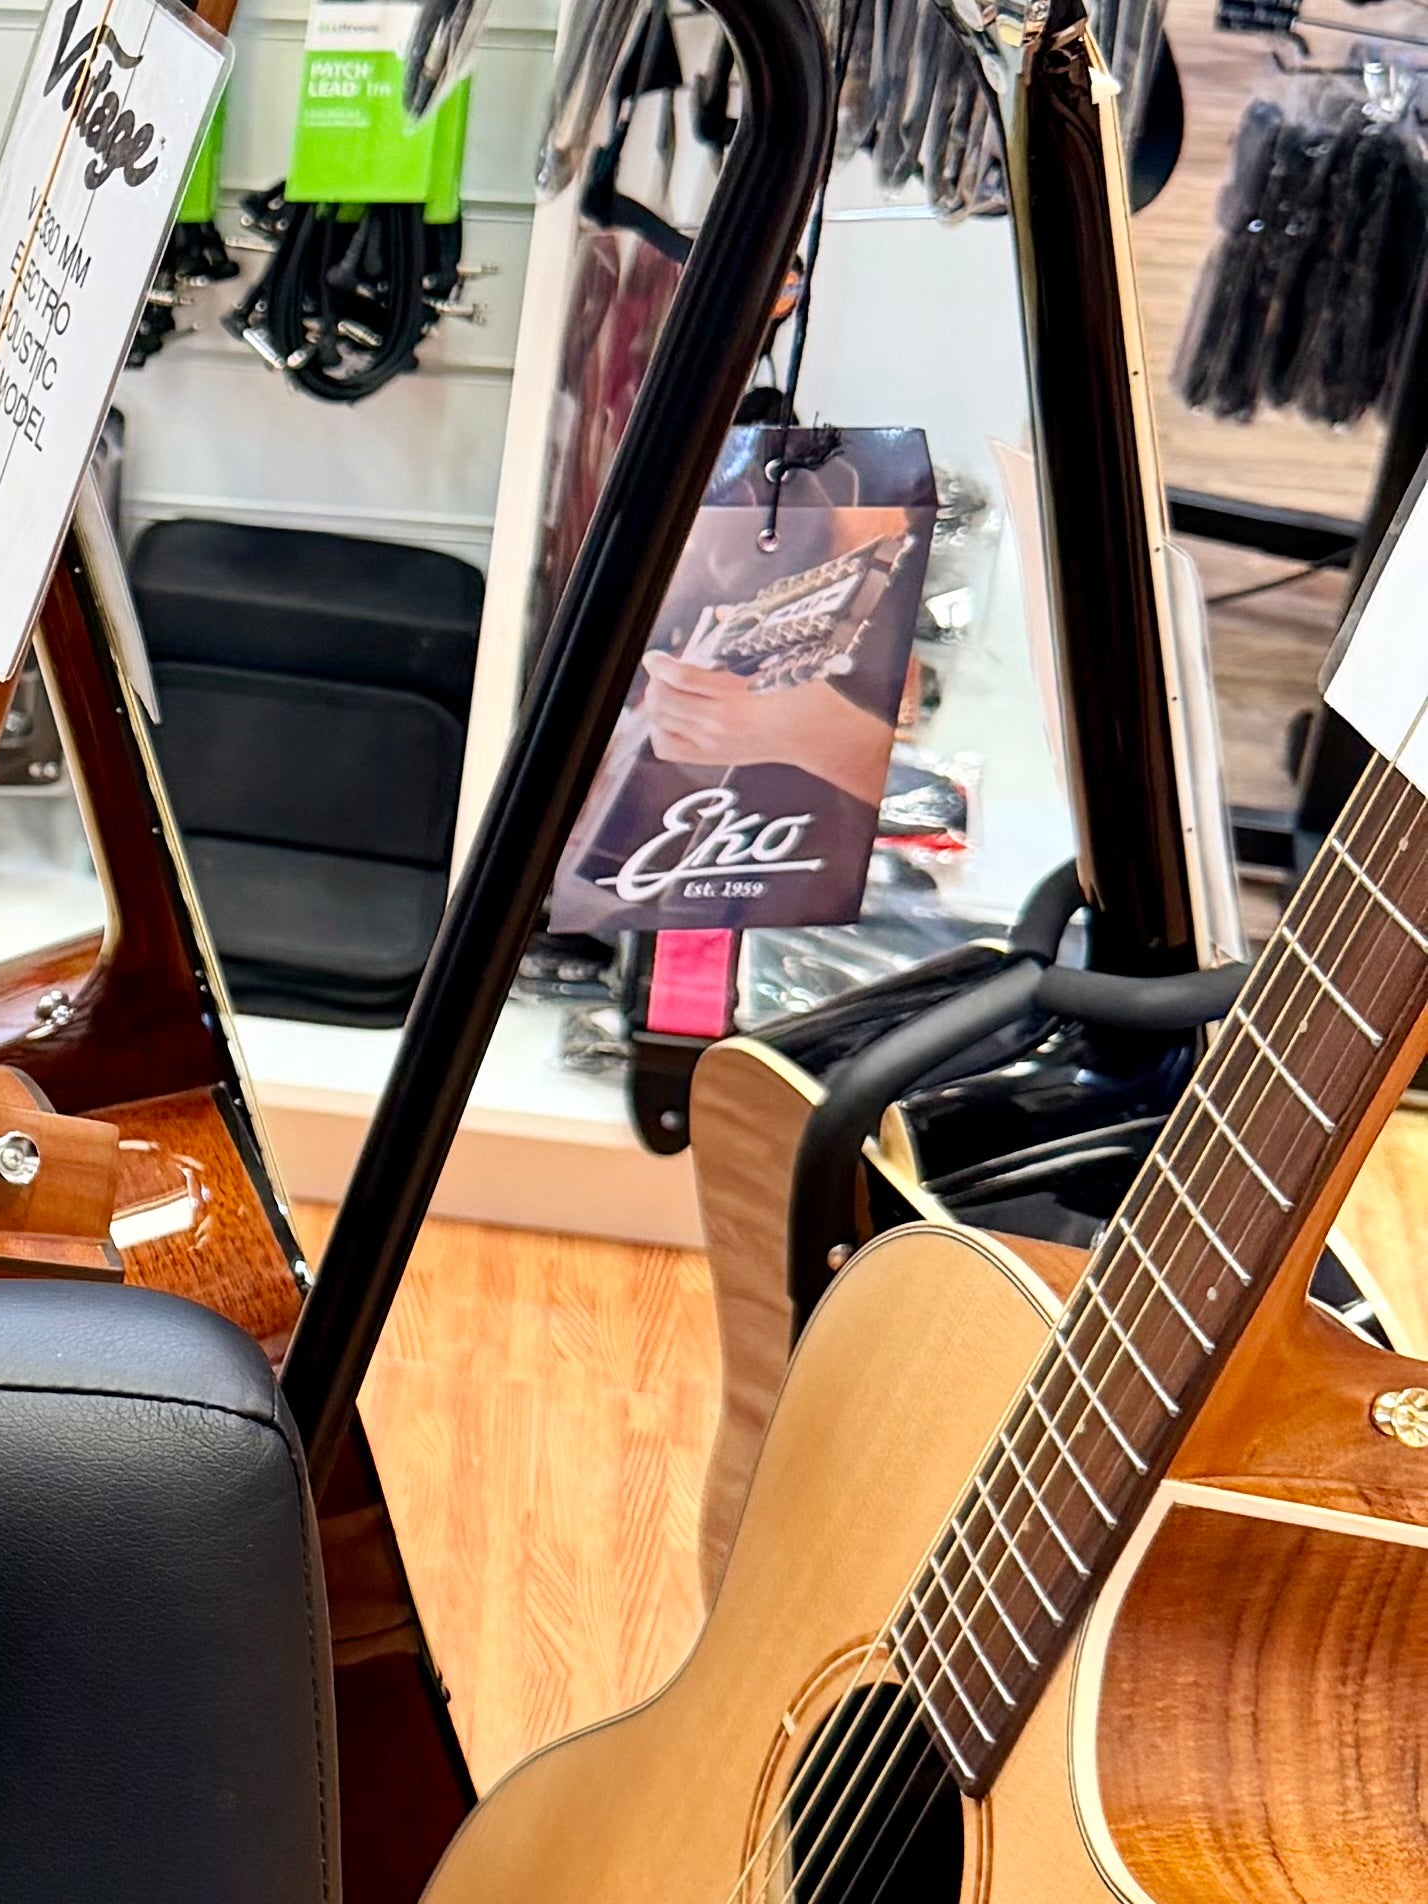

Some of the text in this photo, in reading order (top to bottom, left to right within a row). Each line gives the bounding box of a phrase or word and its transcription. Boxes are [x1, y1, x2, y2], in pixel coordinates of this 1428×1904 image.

[307, 78, 356, 97] LEAD
[310, 59, 370, 79] PATCH
[58, 234, 92, 289] MM
[10, 239, 72, 337] EECTRO
[615, 787, 812, 902] Eko
[684, 881, 765, 897] Est. 1959
